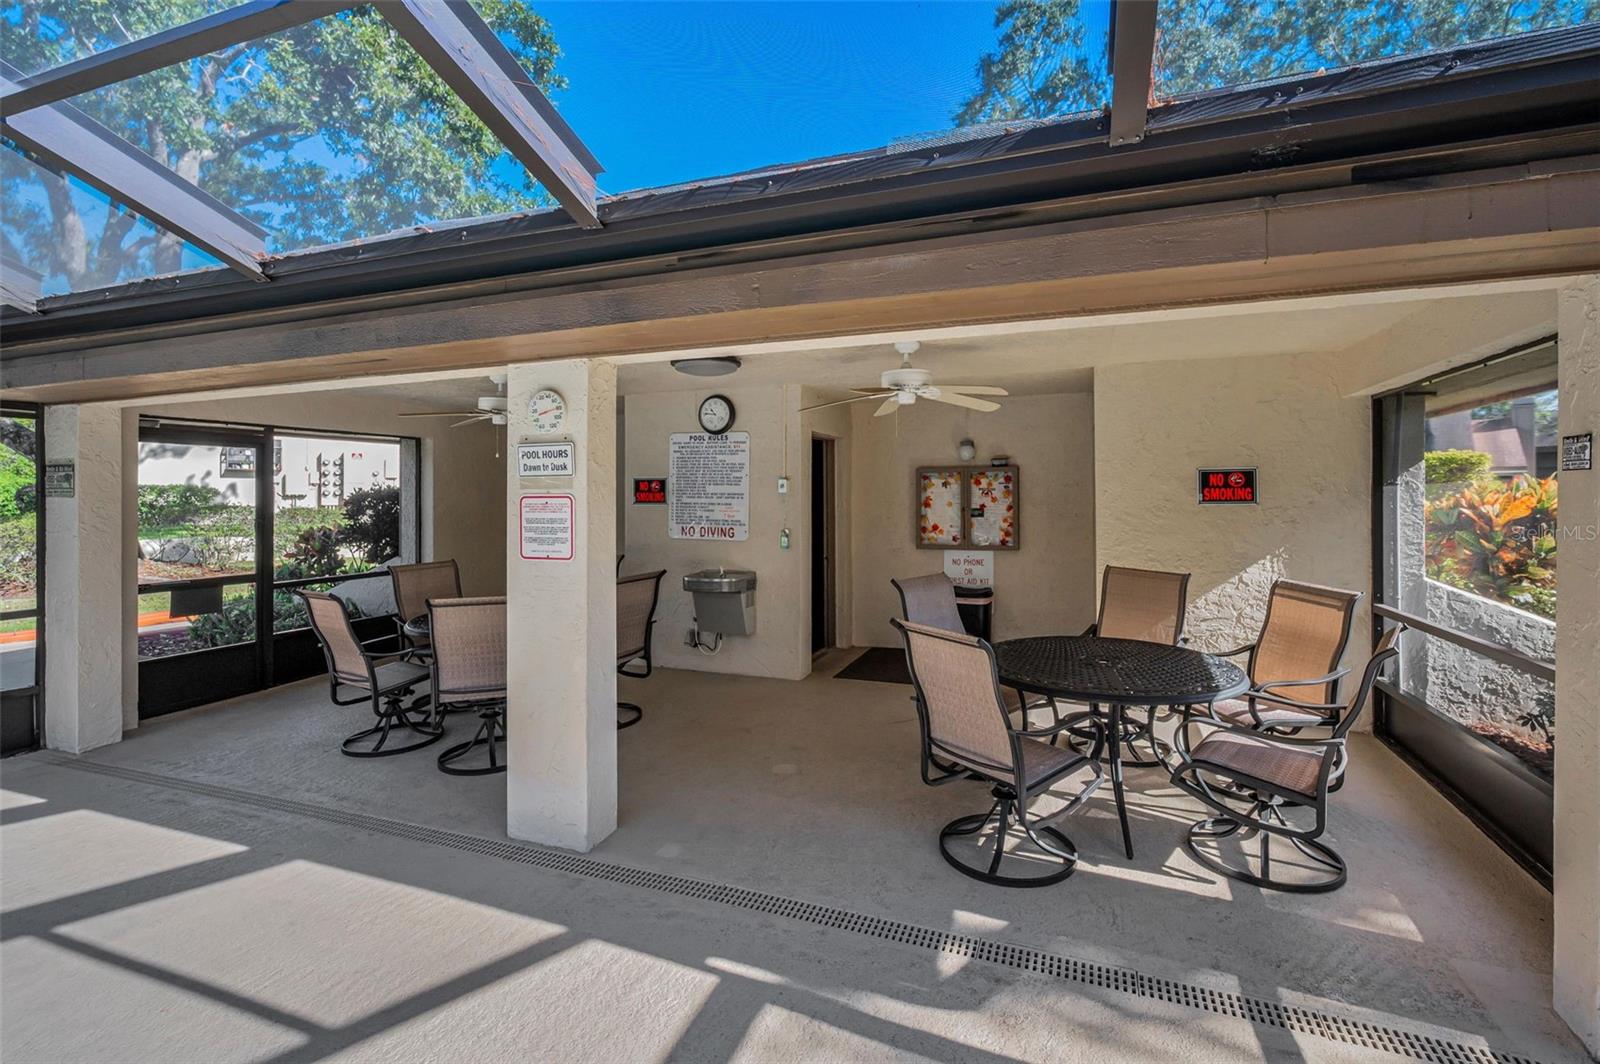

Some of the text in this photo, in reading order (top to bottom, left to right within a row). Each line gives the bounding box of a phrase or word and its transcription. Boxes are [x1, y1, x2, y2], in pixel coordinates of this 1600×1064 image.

[522, 450, 568, 460] POOL HOURS
[524, 464, 541, 472] Dawn
[551, 463, 568, 471] Dusk
[1209, 473, 1224, 486] NO
[1204, 488, 1252, 500] SMOKING
[681, 526, 735, 538] NO DIVING
